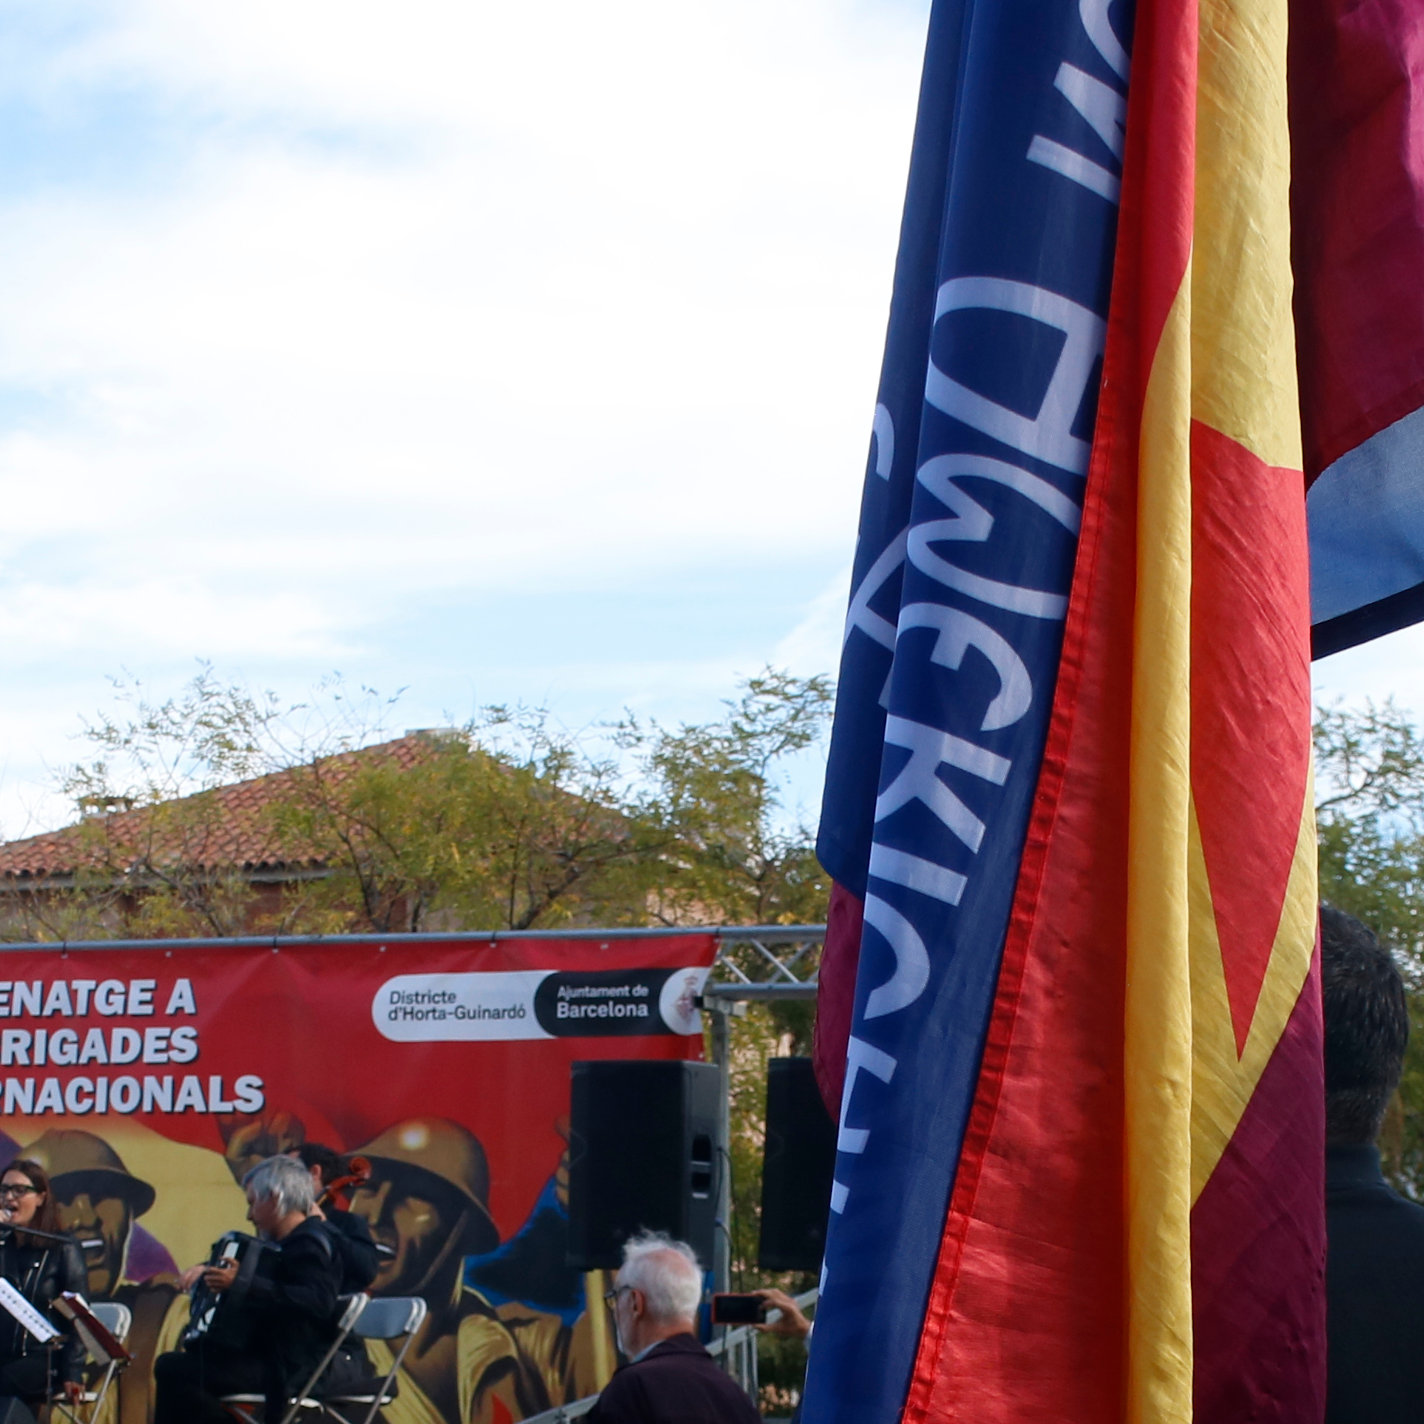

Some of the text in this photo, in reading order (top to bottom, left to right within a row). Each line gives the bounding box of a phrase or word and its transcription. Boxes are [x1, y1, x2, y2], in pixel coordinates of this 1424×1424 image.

[165, 978, 197, 1015] A
[389, 990, 457, 1005] Districte
[557, 985, 649, 999] Ajuntament de
[388, 1003, 526, 1022] d'Horta-Guinardó
[556, 1001, 649, 1019] Barcelona
